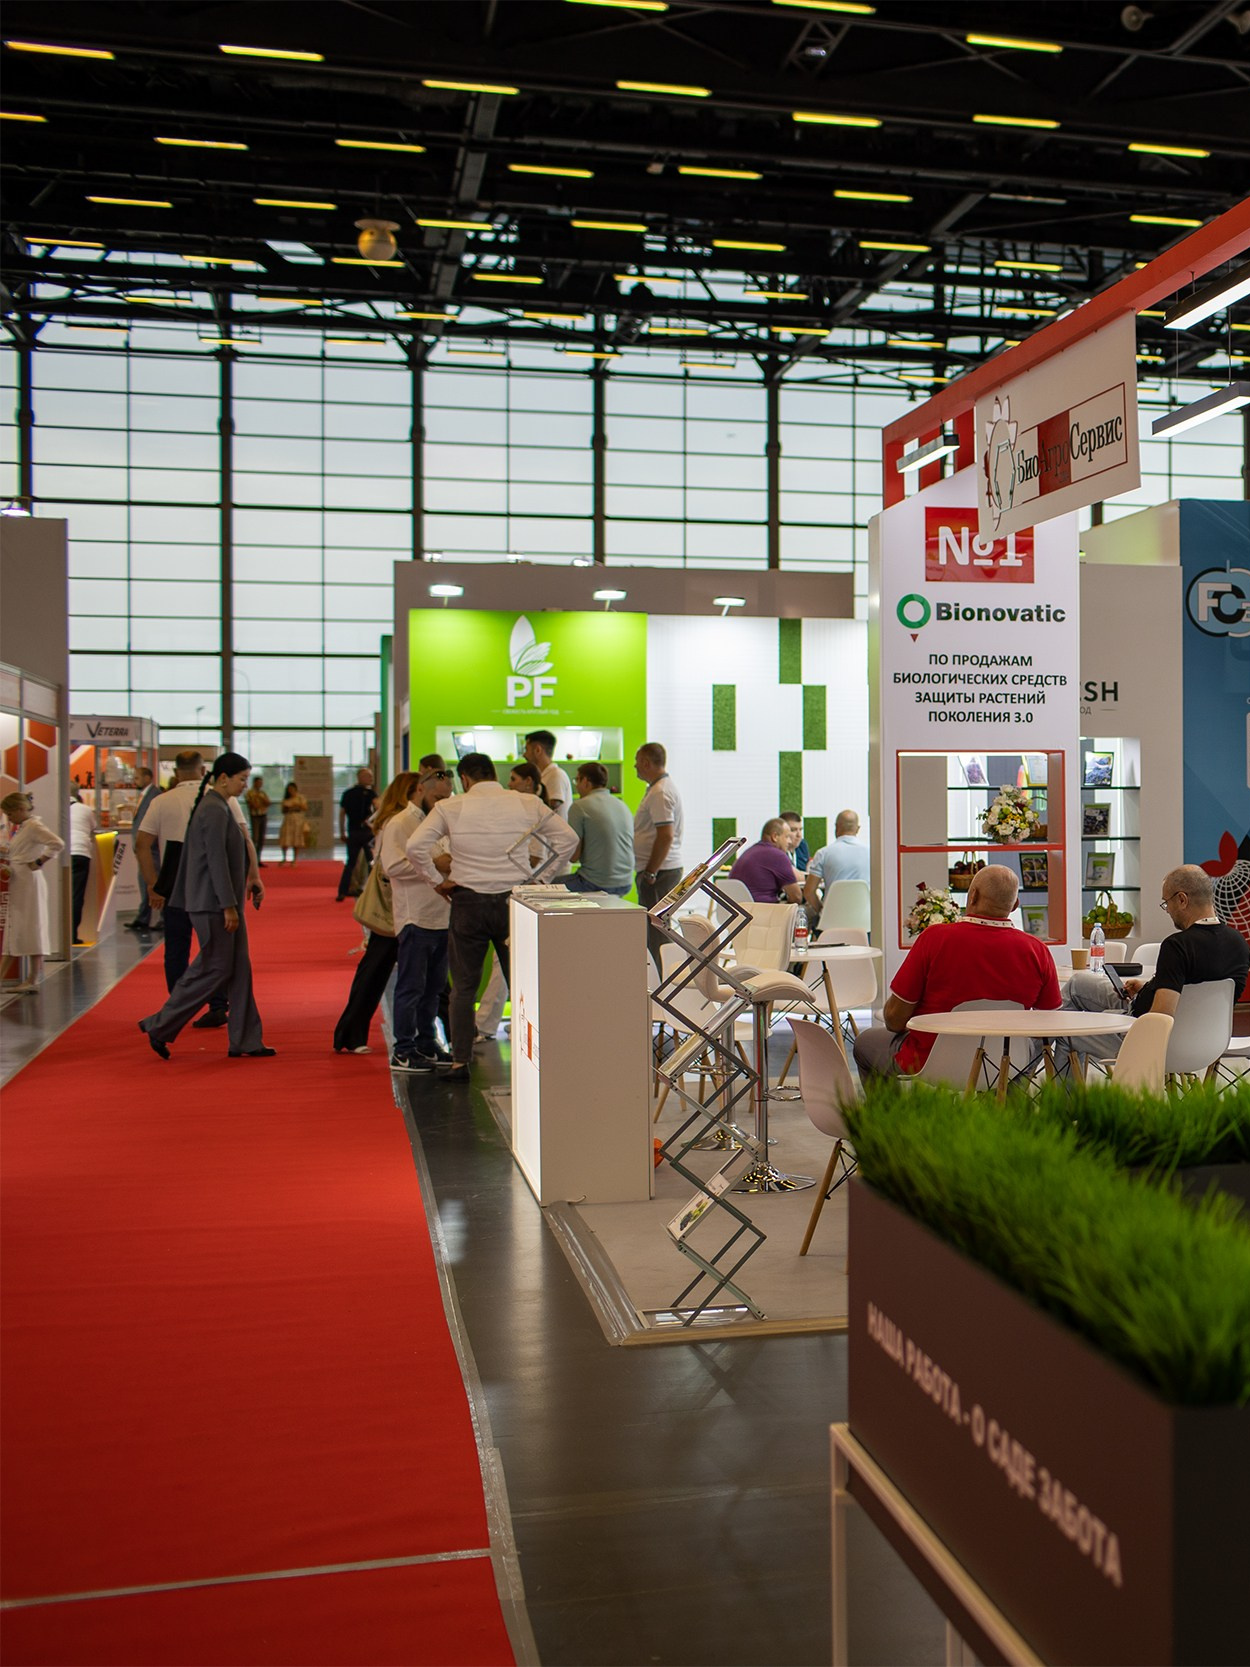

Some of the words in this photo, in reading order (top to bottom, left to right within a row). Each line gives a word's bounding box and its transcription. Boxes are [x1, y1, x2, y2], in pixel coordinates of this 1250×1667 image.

[936, 602, 1066, 622] Bionovatic
[928, 654, 949, 666] ПО
[952, 655, 1033, 668] ПРОДАЖАМ
[893, 673, 1008, 685] БИОЛОГИЧЕСКИХ
[1011, 674, 1068, 687] СРЕДСТВ
[506, 676, 558, 707] PF
[914, 692, 975, 705] ЗАЩИТЫ
[979, 691, 1046, 704] РАСТЕНИЙ
[1080, 681, 1119, 702] SH
[928, 711, 1011, 723] ПОКОЛЕНИЯ
[1014, 712, 1034, 723] 3.0
[1080, 706, 1092, 715] ОД
[86, 722, 129, 738] VETERRA
[867, 1300, 905, 1368] НАША
[905, 1337, 962, 1426] РАБОТА
[970, 1403, 985, 1448] О
[986, 1418, 1036, 1499] САДЕ
[1037, 1466, 1123, 1589] ЗАБОТА
